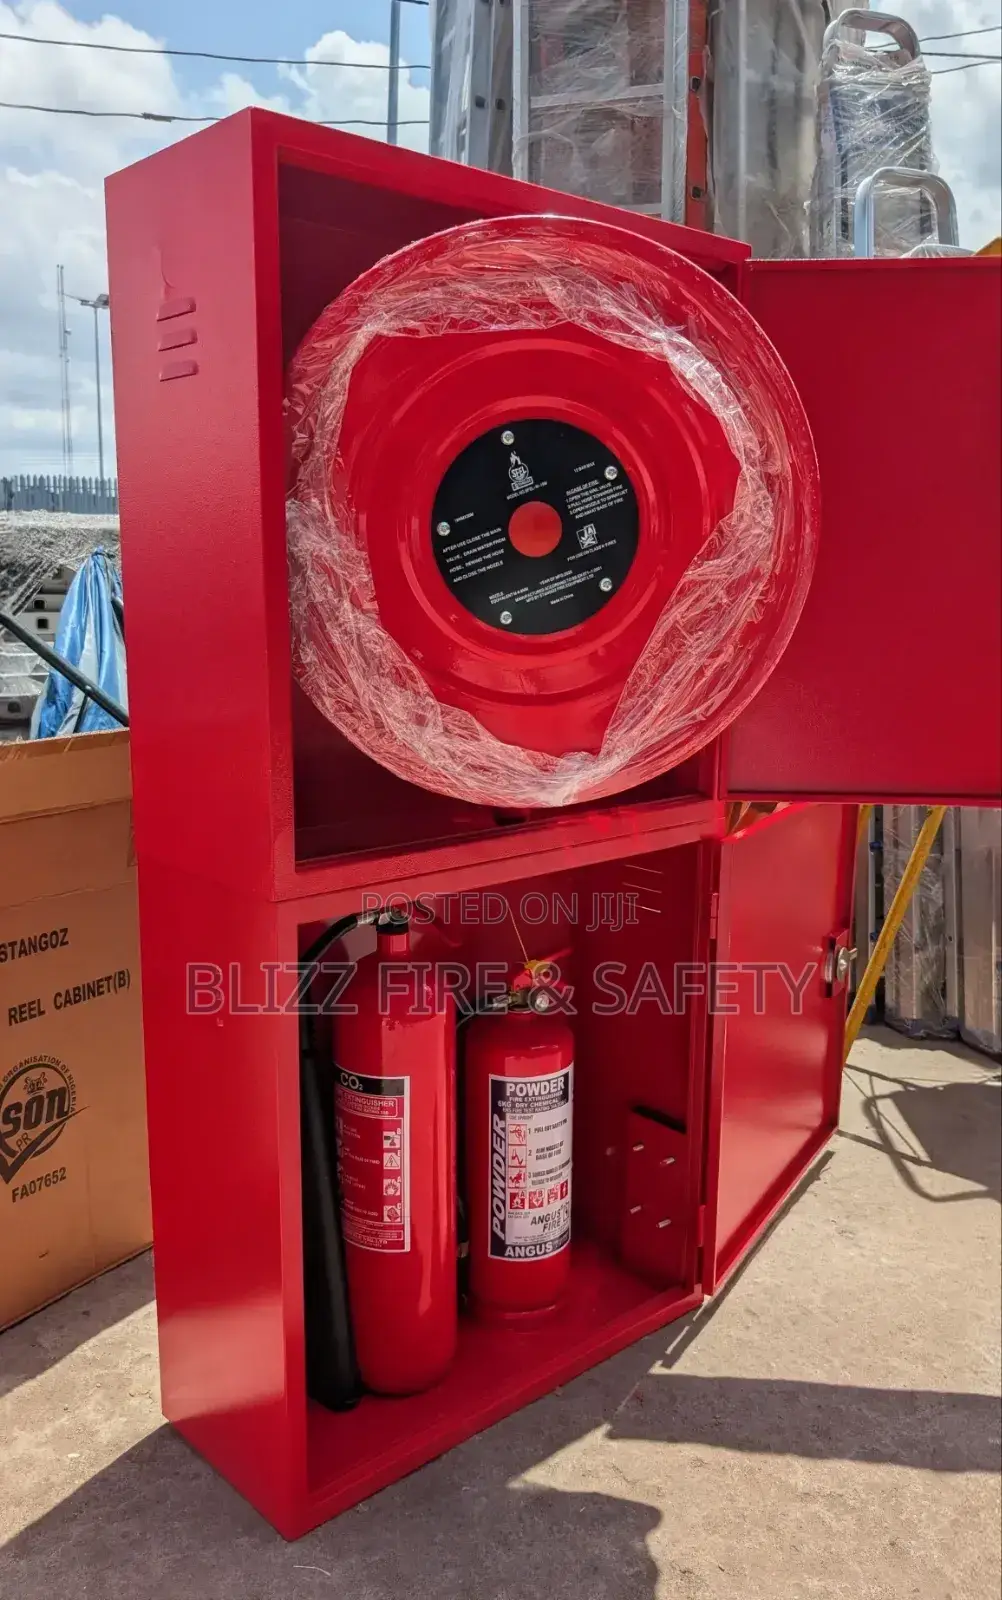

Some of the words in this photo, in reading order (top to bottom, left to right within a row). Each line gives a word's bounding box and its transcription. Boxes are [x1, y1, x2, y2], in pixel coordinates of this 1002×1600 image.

[443, 545, 457, 553] AFTER
[457, 540, 466, 548] USE
[466, 536, 481, 544] CLOSE
[464, 548, 477, 556] DRAIN
[477, 542, 493, 551] WATER
[493, 537, 506, 545] FROM
[492, 548, 504, 556] HOSE
[463, 571, 477, 579] CLOSE
[487, 560, 504, 570] NOZZLE
[0, 928, 69, 963] STANGOZ
[8, 998, 46, 1026] REEL
[54, 969, 131, 1010] CABINET(B)
[3, 1054, 61, 1082] ORGANISATION
[61, 1063, 69, 1073] OF
[68, 1073, 76, 1112] NIGERIA
[506, 1076, 564, 1096] POWDER
[344, 1092, 394, 1107] EXTINGUISHER
[524, 1090, 563, 1102] EXTINGUISHER
[530, 1098, 558, 1107] CHEMICAL
[16, 1132, 32, 1151] PR
[12, 1167, 66, 1202] FA07652
[493, 1114, 505, 1240] POWDER
[531, 1209, 560, 1225] ANGUS
[543, 1218, 560, 1232] FIRE
[505, 1242, 552, 1257] ANGUS
